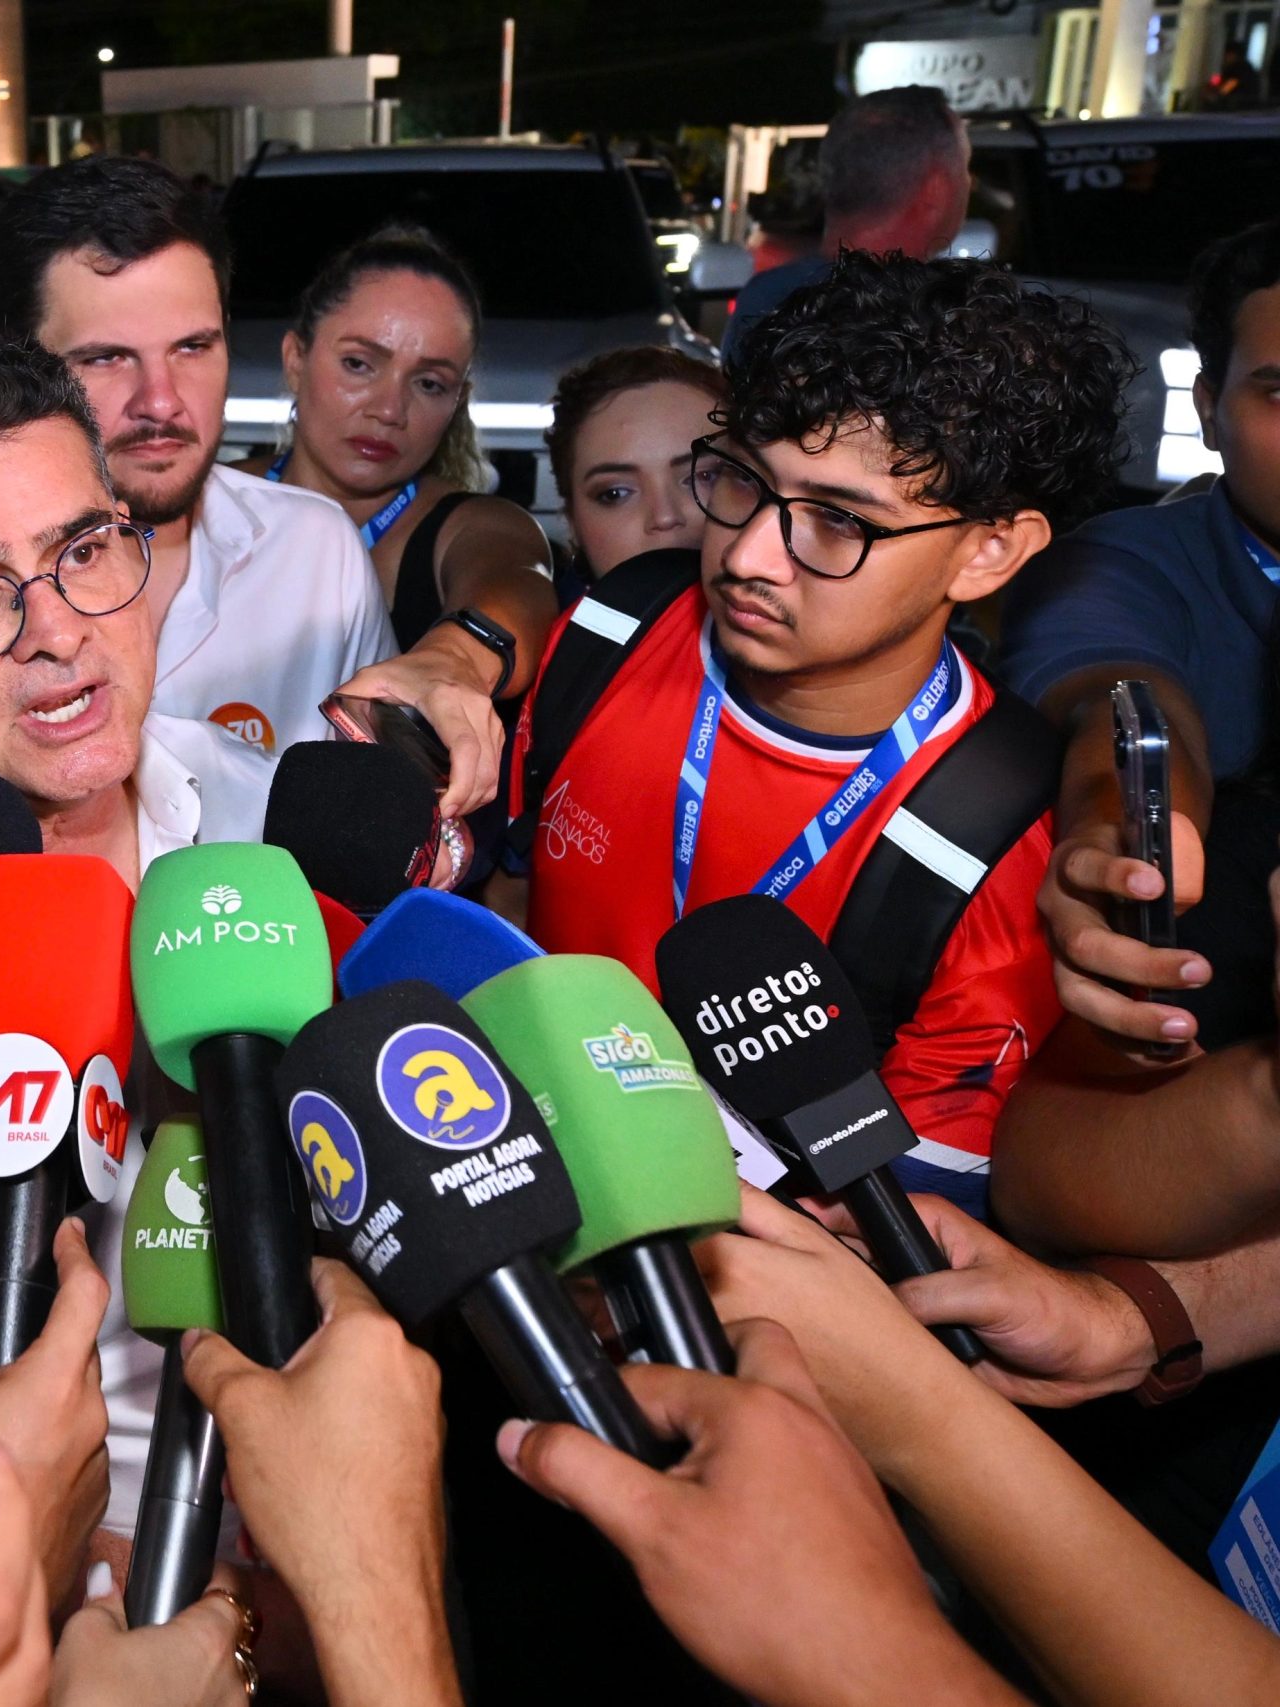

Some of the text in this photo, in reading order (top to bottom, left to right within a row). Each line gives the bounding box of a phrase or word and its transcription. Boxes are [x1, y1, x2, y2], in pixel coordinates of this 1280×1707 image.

[1047, 165, 1123, 192] 70
[833, 767, 877, 818] ELEIÇÕES
[562, 796, 612, 847] PORTAL
[154, 920, 298, 955] AM POST
[695, 969, 810, 1035] direto
[590, 1037, 652, 1065] SIGO
[7, 1131, 51, 1142] BRASIL
[809, 1108, 889, 1155] @DiretoAoPonto
[430, 1133, 543, 1196] PORTAL AGORA
